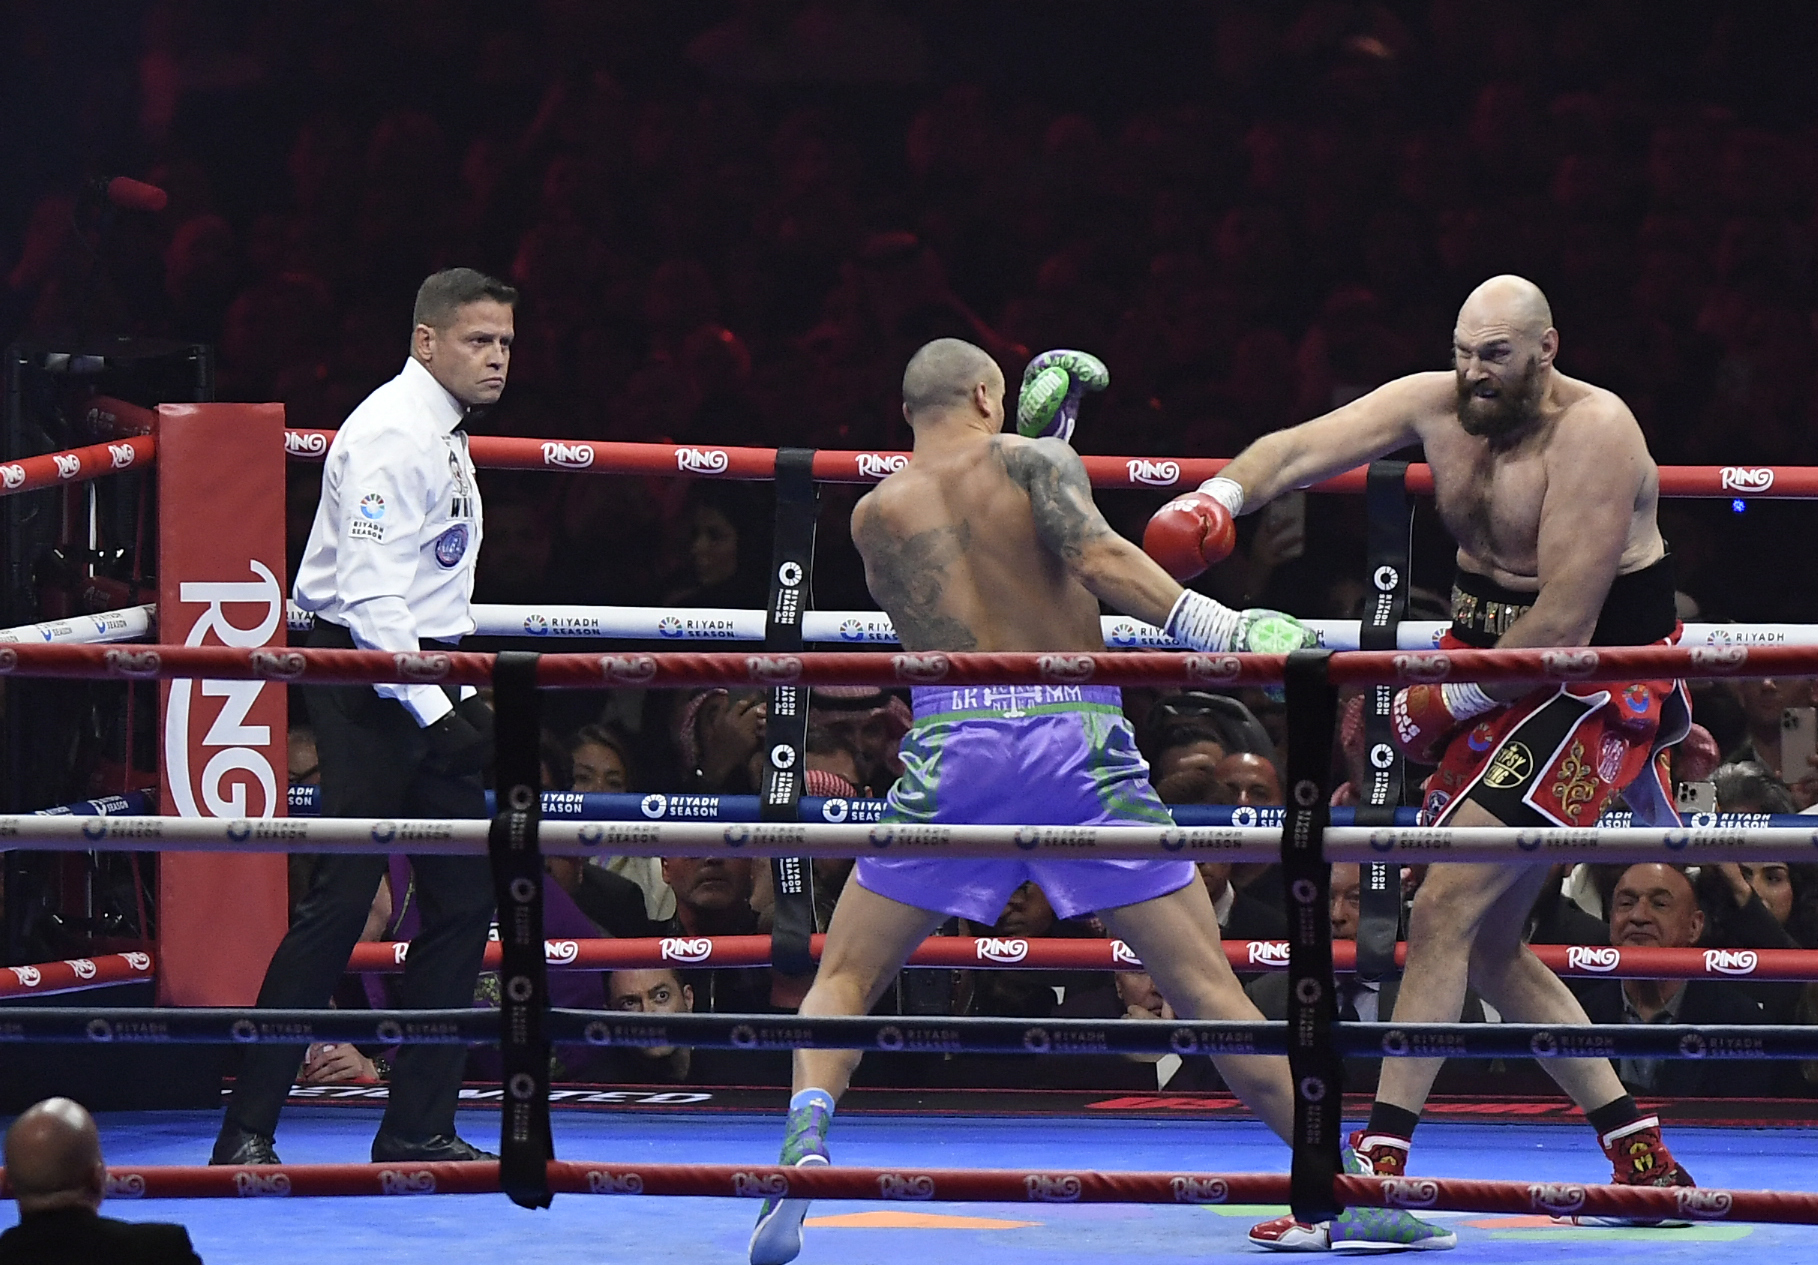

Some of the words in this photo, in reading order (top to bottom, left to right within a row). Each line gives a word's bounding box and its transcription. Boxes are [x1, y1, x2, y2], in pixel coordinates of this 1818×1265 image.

[541, 442, 594, 468] RING
[675, 448, 728, 474] RING
[855, 454, 909, 478] RING
[1126, 459, 1179, 485] RING
[1719, 467, 1774, 492] RING
[353, 521, 384, 533] RIYADH
[351, 528, 383, 540] SEASON
[788, 589, 799, 624] RIYADH
[1380, 594, 1393, 626] RIYADH
[552, 618, 599, 627] RIYADH
[687, 620, 734, 629] RIYADH
[868, 623, 893, 632] RIY
[868, 633, 898, 641] SEAS
[1140, 627, 1166, 636] RIY
[1736, 633, 1784, 641] RIYADH
[165, 559, 282, 818] RNG
[781, 686, 789, 715] EASON
[788, 686, 796, 715] IYADH
[288, 787, 313, 795] ADH
[784, 772, 793, 804] RIYADH
[1378, 772, 1389, 805] RIYADH
[288, 796, 312, 806] SON
[541, 793, 584, 803] IYADH
[670, 796, 719, 806] RIYADH
[541, 803, 582, 814] EASON
[669, 806, 718, 817] SEASON
[851, 801, 886, 811] RIYA
[851, 811, 881, 821] SEAS
[1260, 809, 1287, 818] RIY
[1602, 811, 1632, 819] ADH
[1720, 813, 1771, 821] RIYADH
[1260, 818, 1284, 828] SEA
[1597, 819, 1631, 828] ASON
[786, 858, 795, 893] SEASON
[793, 858, 802, 893] RIYADH
[1371, 862, 1379, 890] ASON
[545, 940, 579, 964] NG
[660, 938, 712, 962] RING
[974, 938, 1028, 962] RING
[1565, 946, 1620, 972] RING
[1702, 950, 1758, 975] RING
